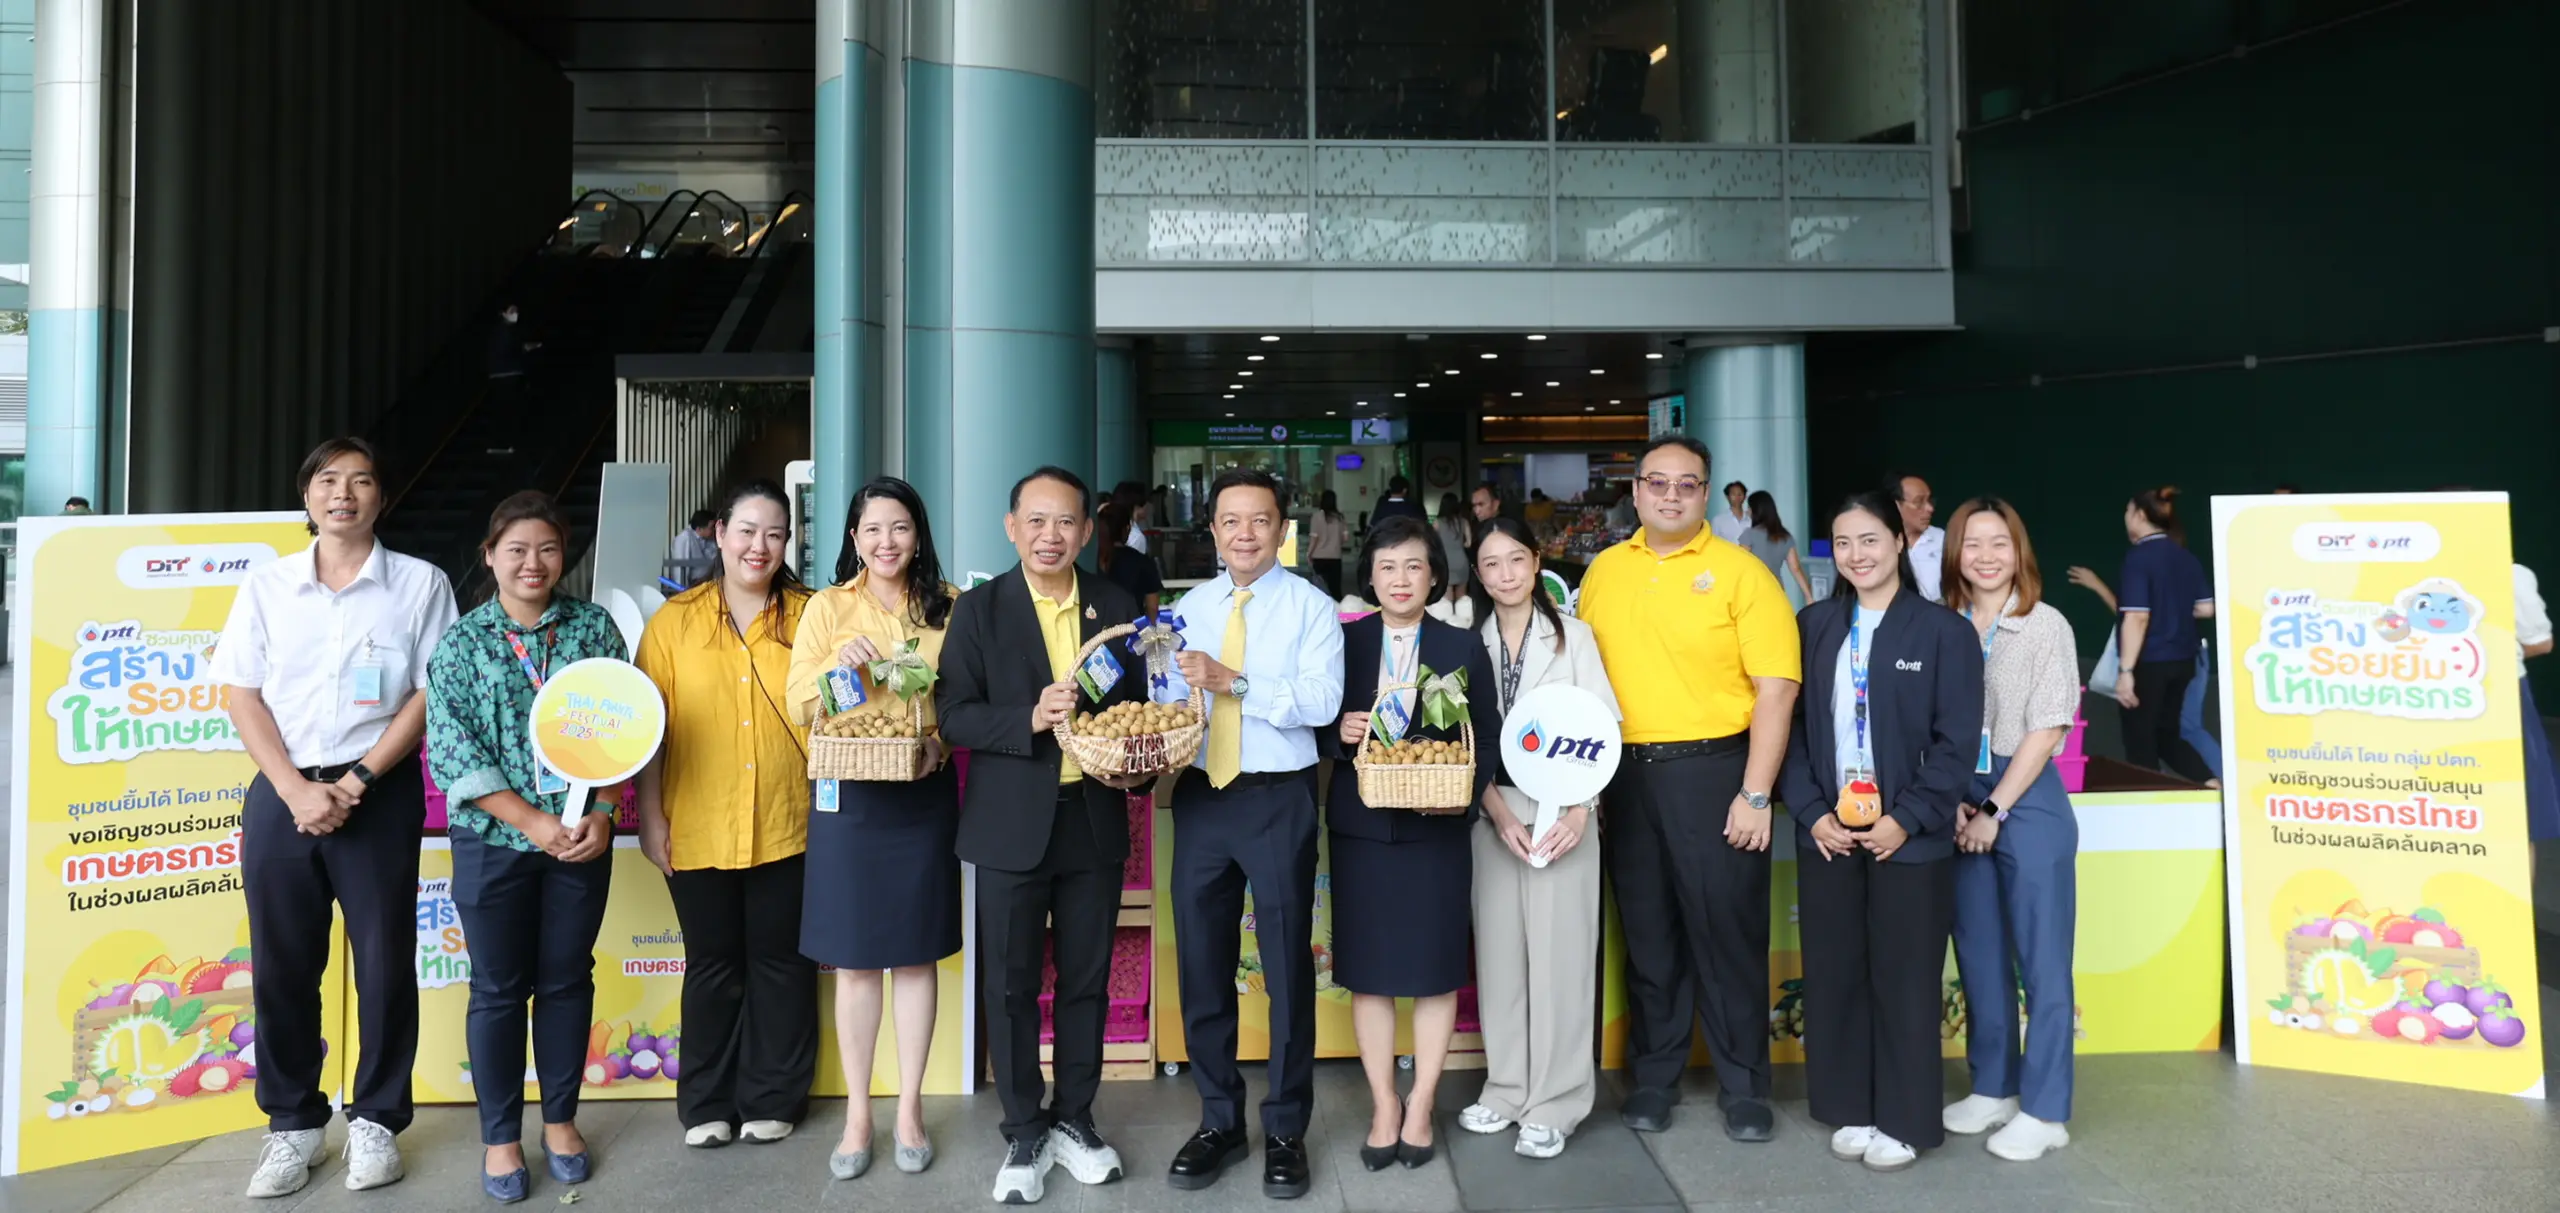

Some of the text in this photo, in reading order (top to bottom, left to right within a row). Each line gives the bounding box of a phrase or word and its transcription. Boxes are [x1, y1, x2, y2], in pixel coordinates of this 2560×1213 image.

[2383, 537, 2411, 549] ptt
[218, 558, 250, 573] ptt
[2284, 595, 2311, 606] ptt
[101, 625, 136, 642] ptt
[145, 633, 211, 650] ชวนคุณ
[2269, 612, 2366, 649] สร้าง
[79, 645, 196, 690] สร้าง
[1905, 660, 1923, 672] ptt
[2308, 636, 2447, 682] รอยยิ้ม
[2256, 652, 2473, 709] ให้เกษตรกร
[560, 722, 592, 739] 2025
[1546, 736, 1606, 763] ptt
[2266, 742, 2354, 764] ชุมชนยิ้มได้
[2358, 747, 2389, 763] โดย
[2394, 750, 2431, 770] กลุ่ม
[2268, 771, 2484, 800] ขอเชิญชวนร่วมสนับสนุน
[68, 789, 172, 822] ชุมชนยิ้มได้
[177, 787, 211, 805] โดย
[2269, 797, 2478, 830] เกษตรกรไทย
[2271, 825, 2488, 857] ในช่วงผลผลิตล้นตลาด
[426, 881, 447, 893] ptt
